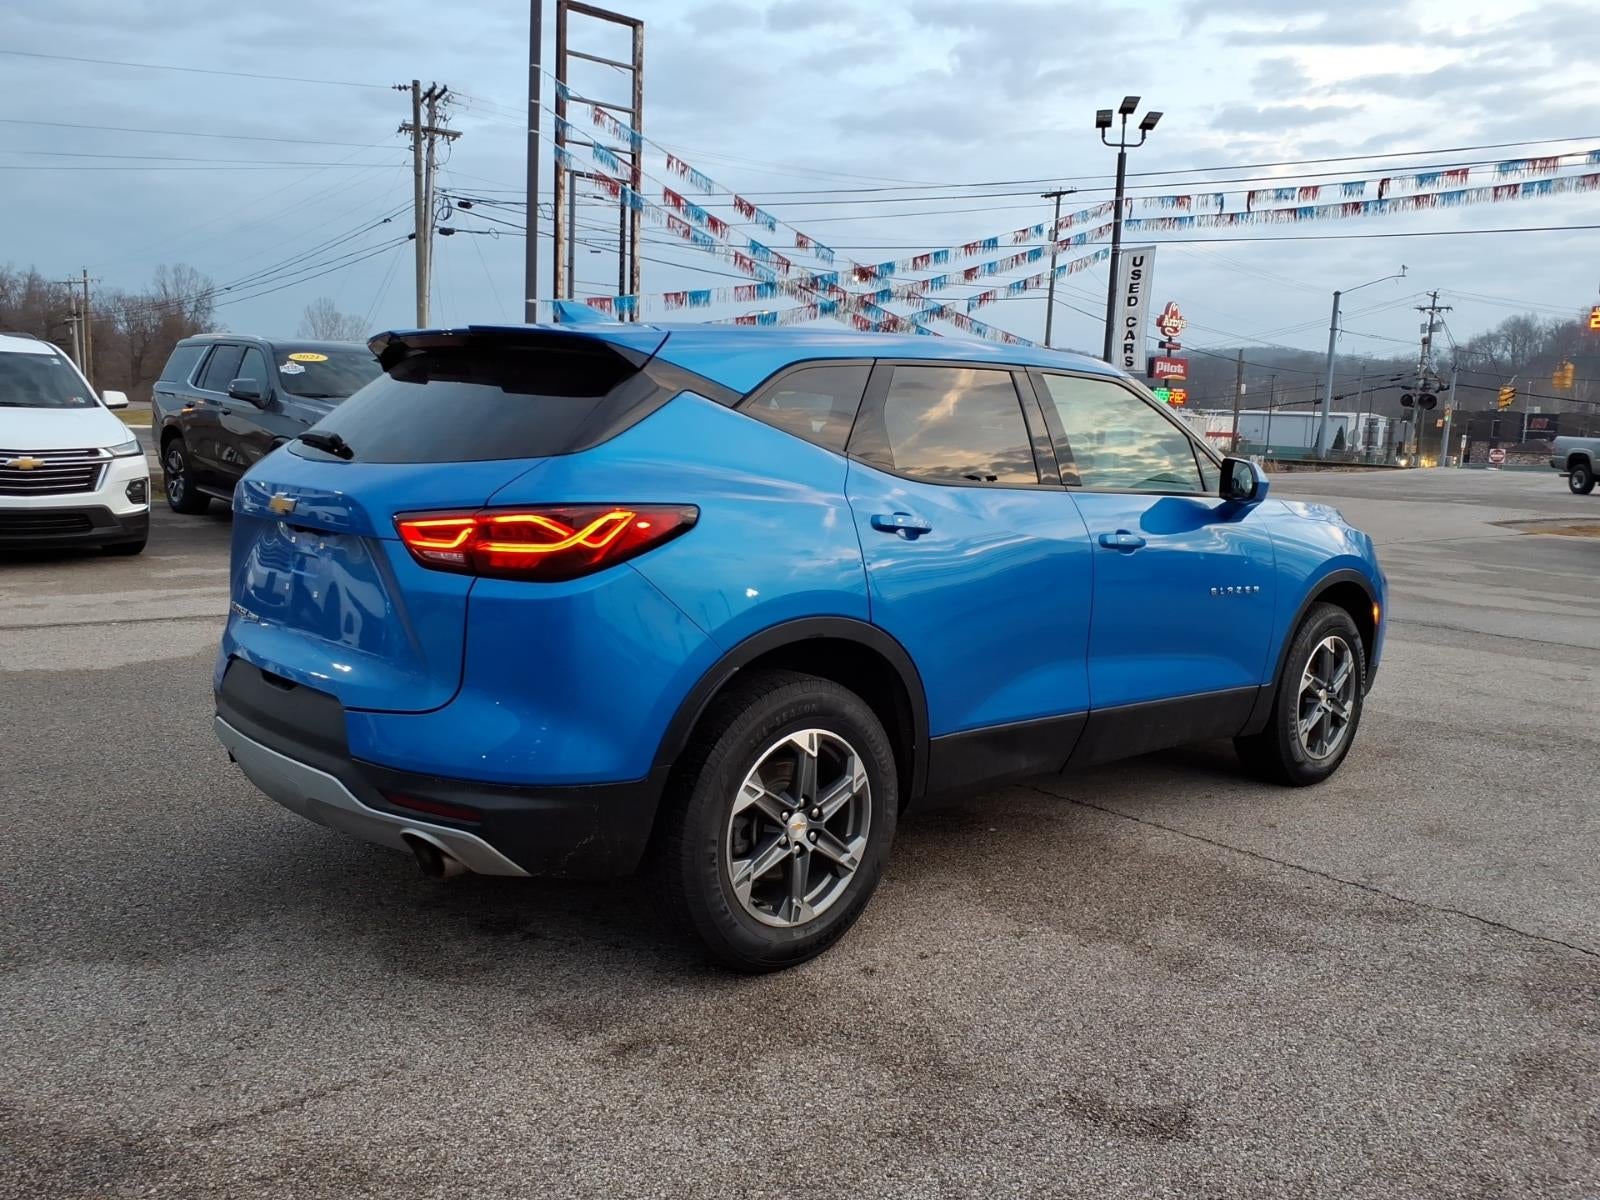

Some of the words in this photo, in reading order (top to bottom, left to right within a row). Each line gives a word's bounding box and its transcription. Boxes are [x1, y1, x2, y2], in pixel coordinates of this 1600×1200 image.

[1127, 255, 1144, 306] USED
[1163, 315, 1187, 330] Arby's
[1123, 316, 1137, 368] CARS
[1155, 361, 1184, 373] Pilot
[1210, 585, 1260, 595] BLAZER
